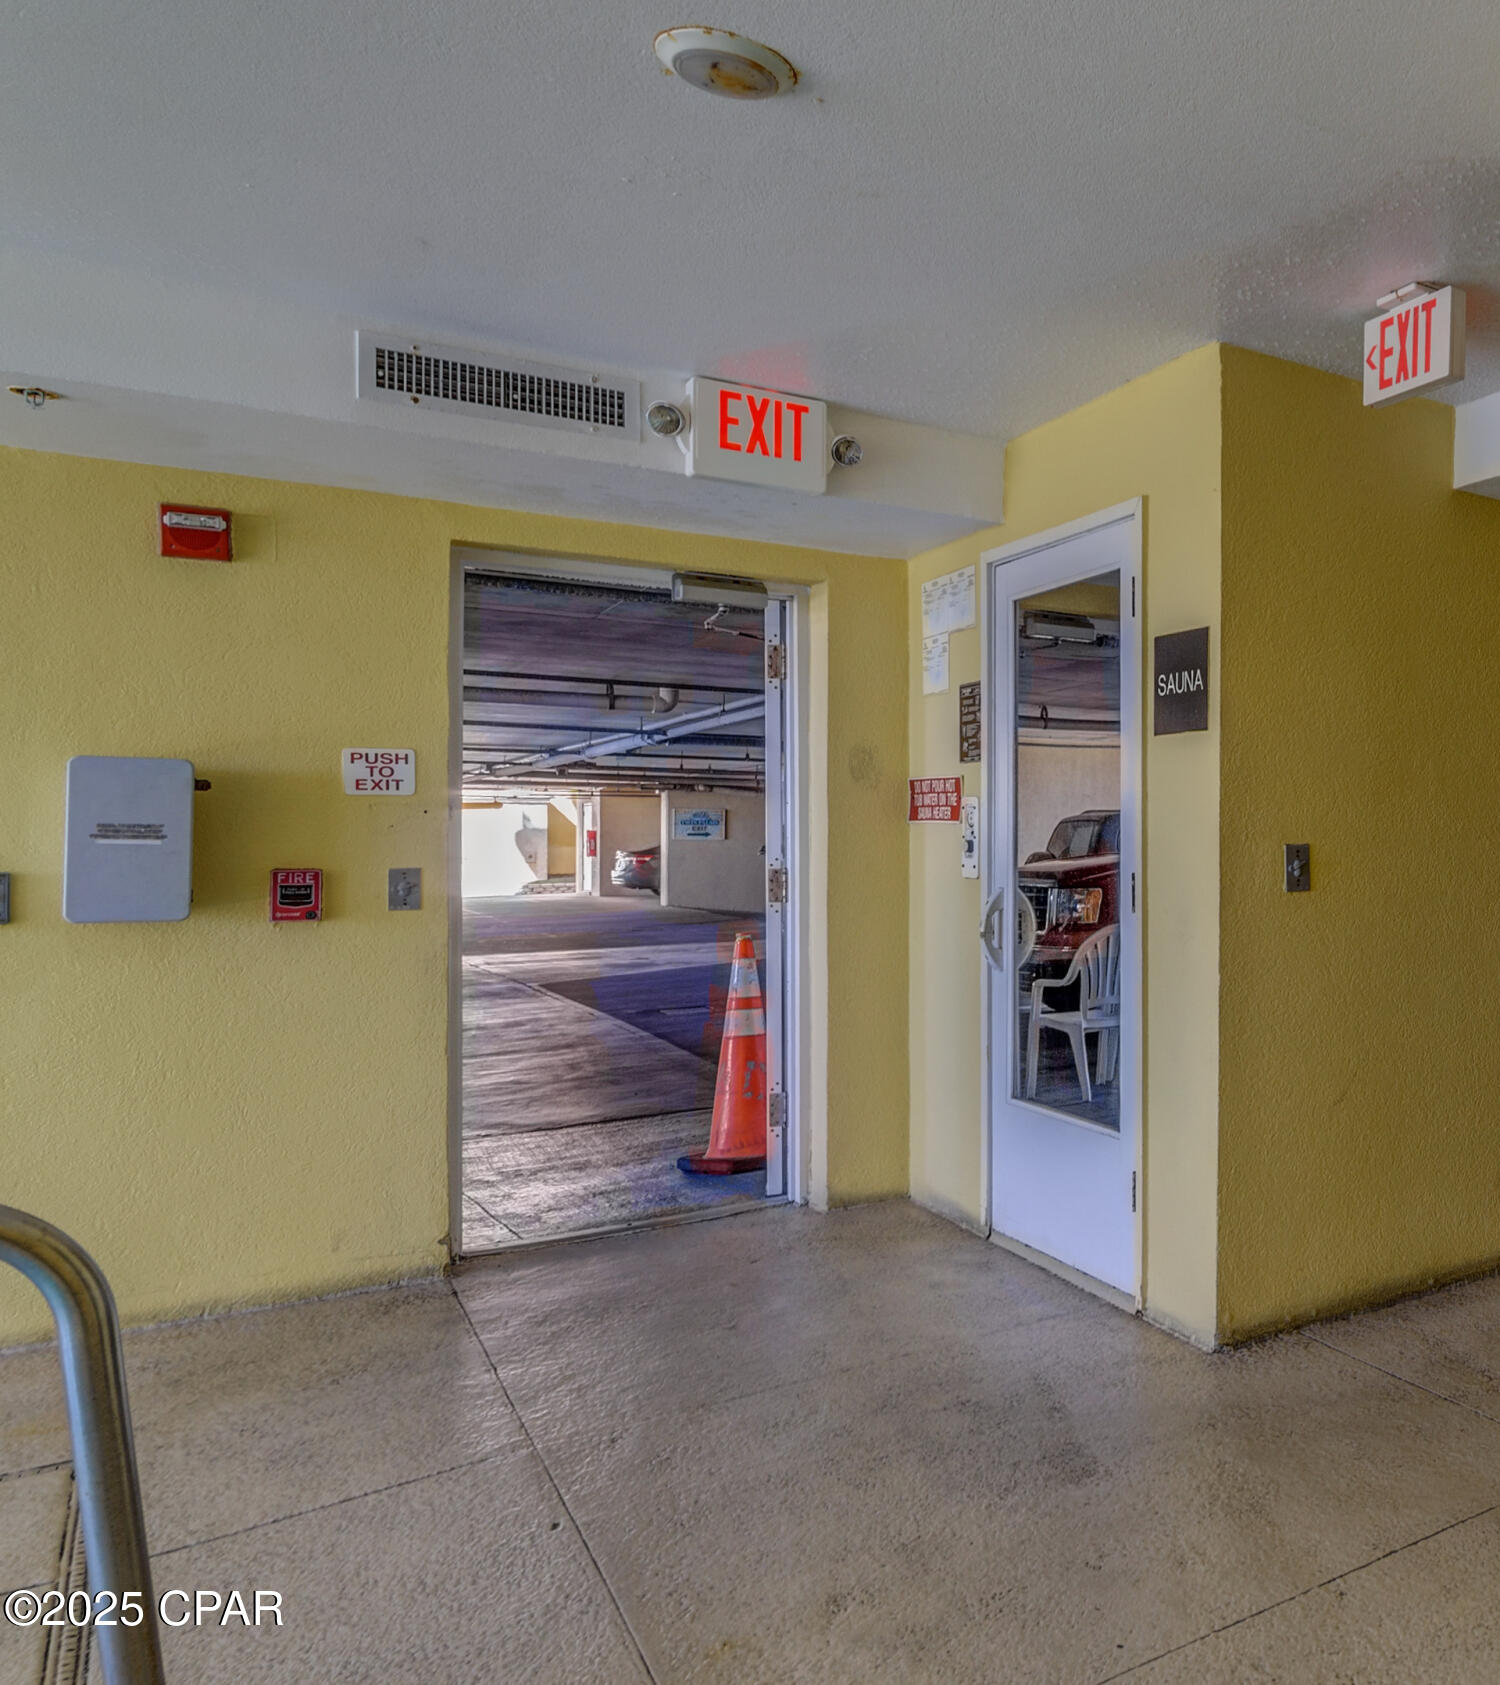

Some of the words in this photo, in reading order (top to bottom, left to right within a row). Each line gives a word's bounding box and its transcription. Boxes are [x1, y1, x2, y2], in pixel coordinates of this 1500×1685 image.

[1379, 298, 1437, 390] EXIT
[719, 389, 810, 462] EXIT
[1157, 668, 1204, 697] SAUNA
[350, 752, 409, 765] PUSH
[365, 765, 395, 778] TO
[355, 778, 405, 791] EXIT
[914, 781, 921, 792] DO
[921, 780, 931, 793] NOT
[931, 779, 945, 793] POUR
[945, 779, 956, 793] HOT
[923, 792, 938, 806] WATER
[938, 792, 947, 806] ON
[947, 792, 958, 806] THE
[932, 806, 952, 820] HEATER
[277, 872, 315, 884] FIRE
